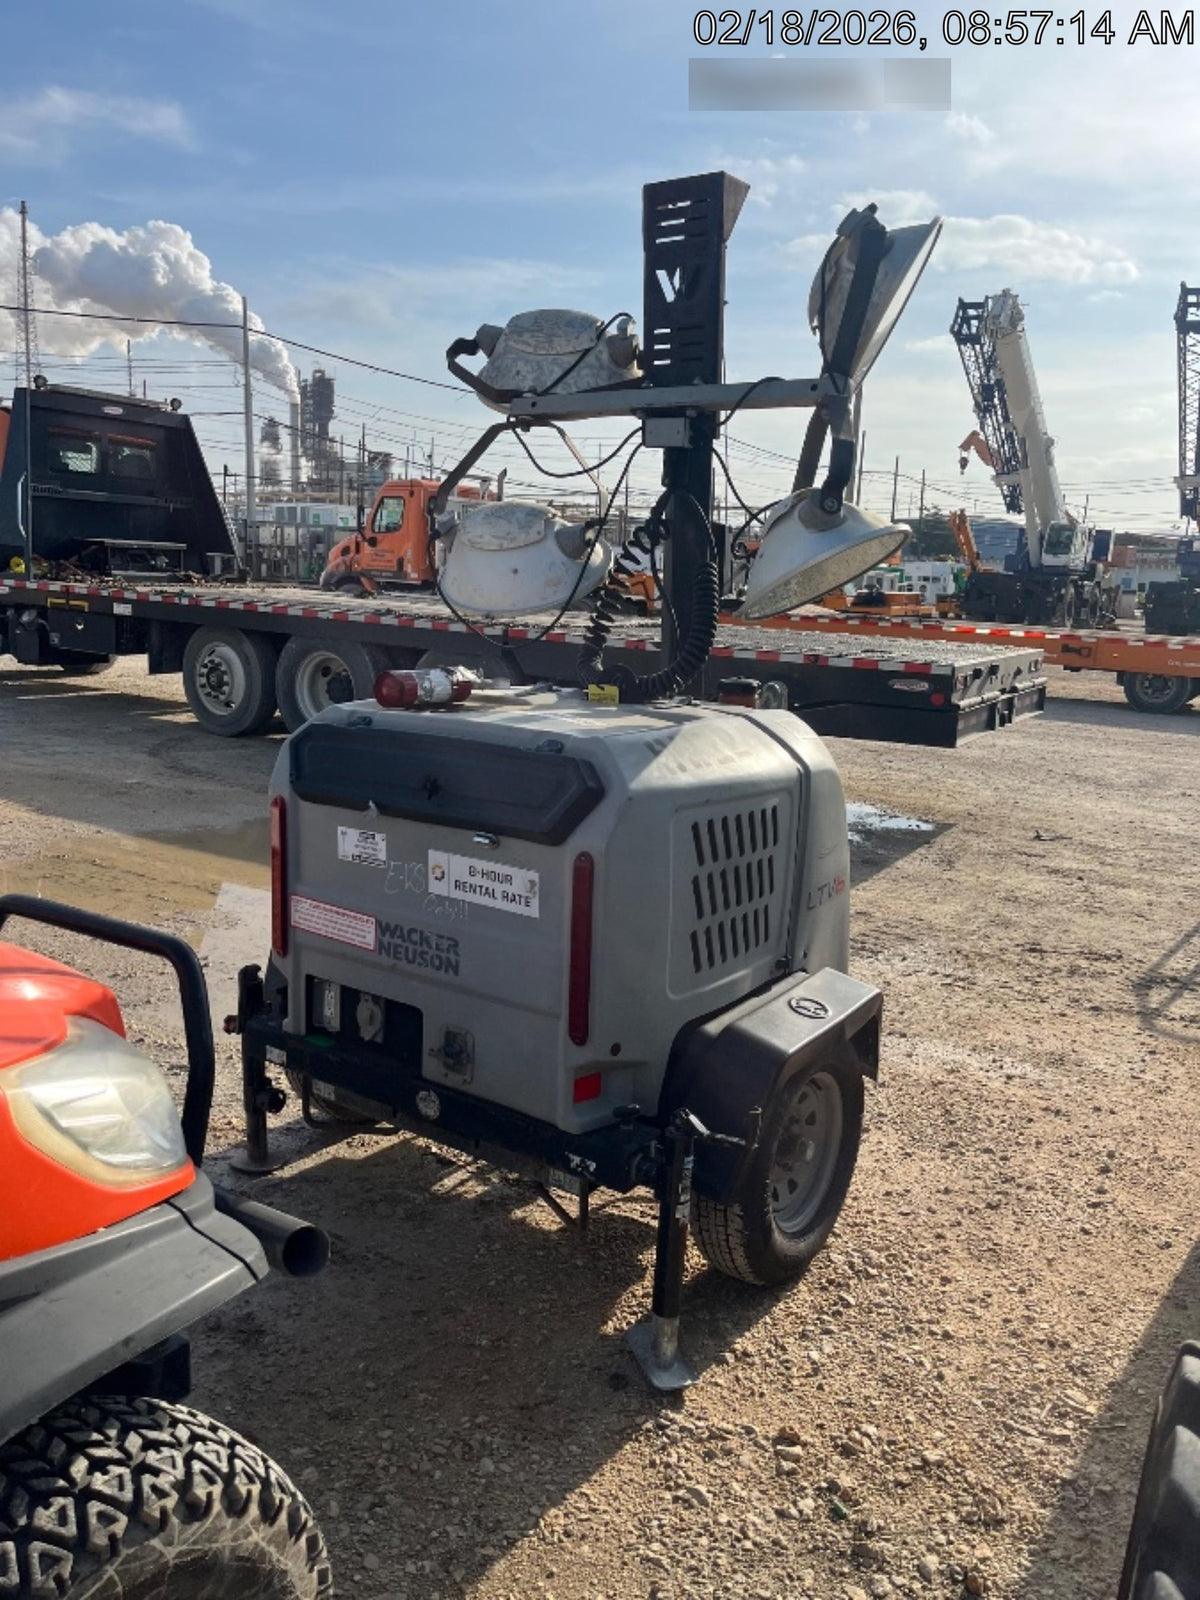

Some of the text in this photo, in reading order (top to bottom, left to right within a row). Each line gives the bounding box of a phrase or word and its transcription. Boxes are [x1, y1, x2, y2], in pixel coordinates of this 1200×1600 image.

[454, 879, 532, 908] RENTAL RATE
[378, 920, 461, 957] WACKER
[378, 938, 461, 976] NEUSON
